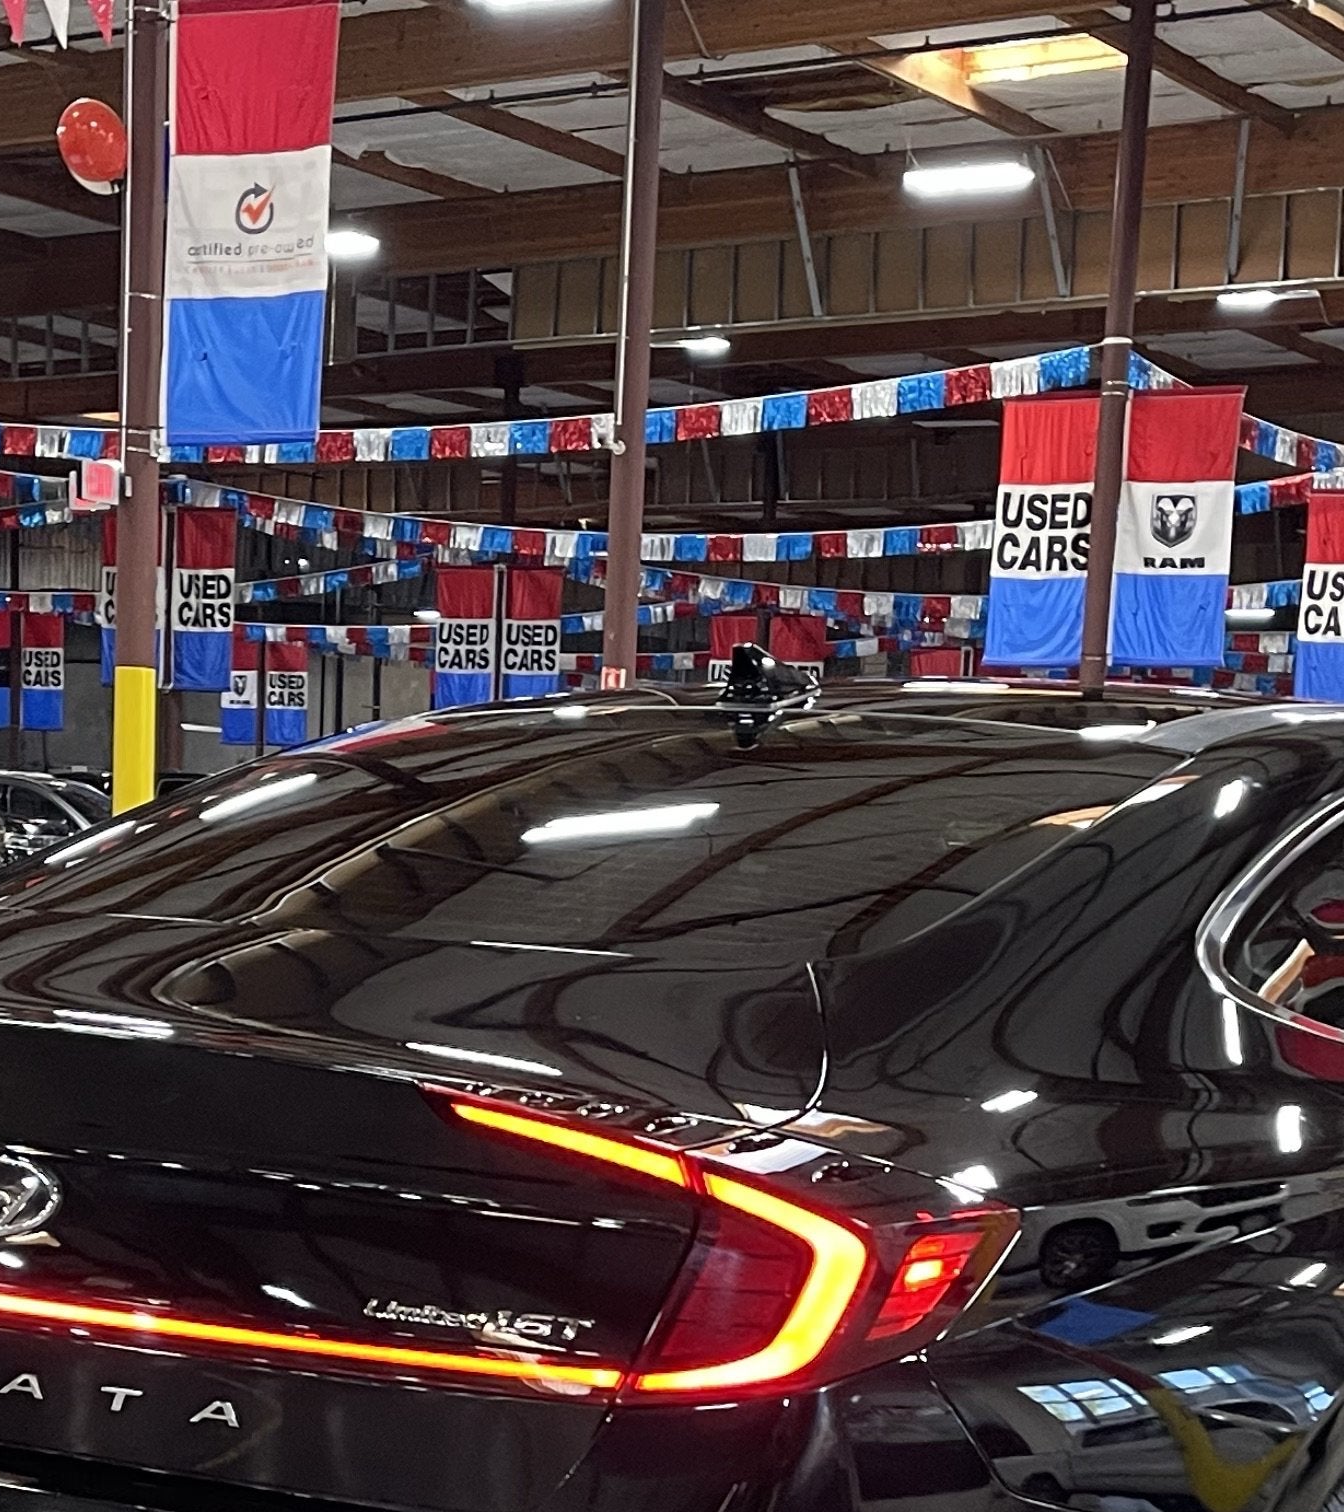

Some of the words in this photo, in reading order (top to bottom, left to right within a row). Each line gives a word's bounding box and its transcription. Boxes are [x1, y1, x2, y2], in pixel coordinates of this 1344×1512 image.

[1002, 492, 1092, 531] USED
[997, 533, 1090, 571] CARS
[1144, 557, 1205, 569] RAM
[180, 572, 231, 600] USED
[178, 602, 231, 628] CARS
[439, 622, 489, 646] USED
[506, 623, 557, 647] USED
[23, 650, 60, 668] USED
[438, 647, 490, 669] CARS
[504, 648, 556, 671] CARS
[269, 673, 304, 690] USED
[268, 691, 305, 707] CARS
